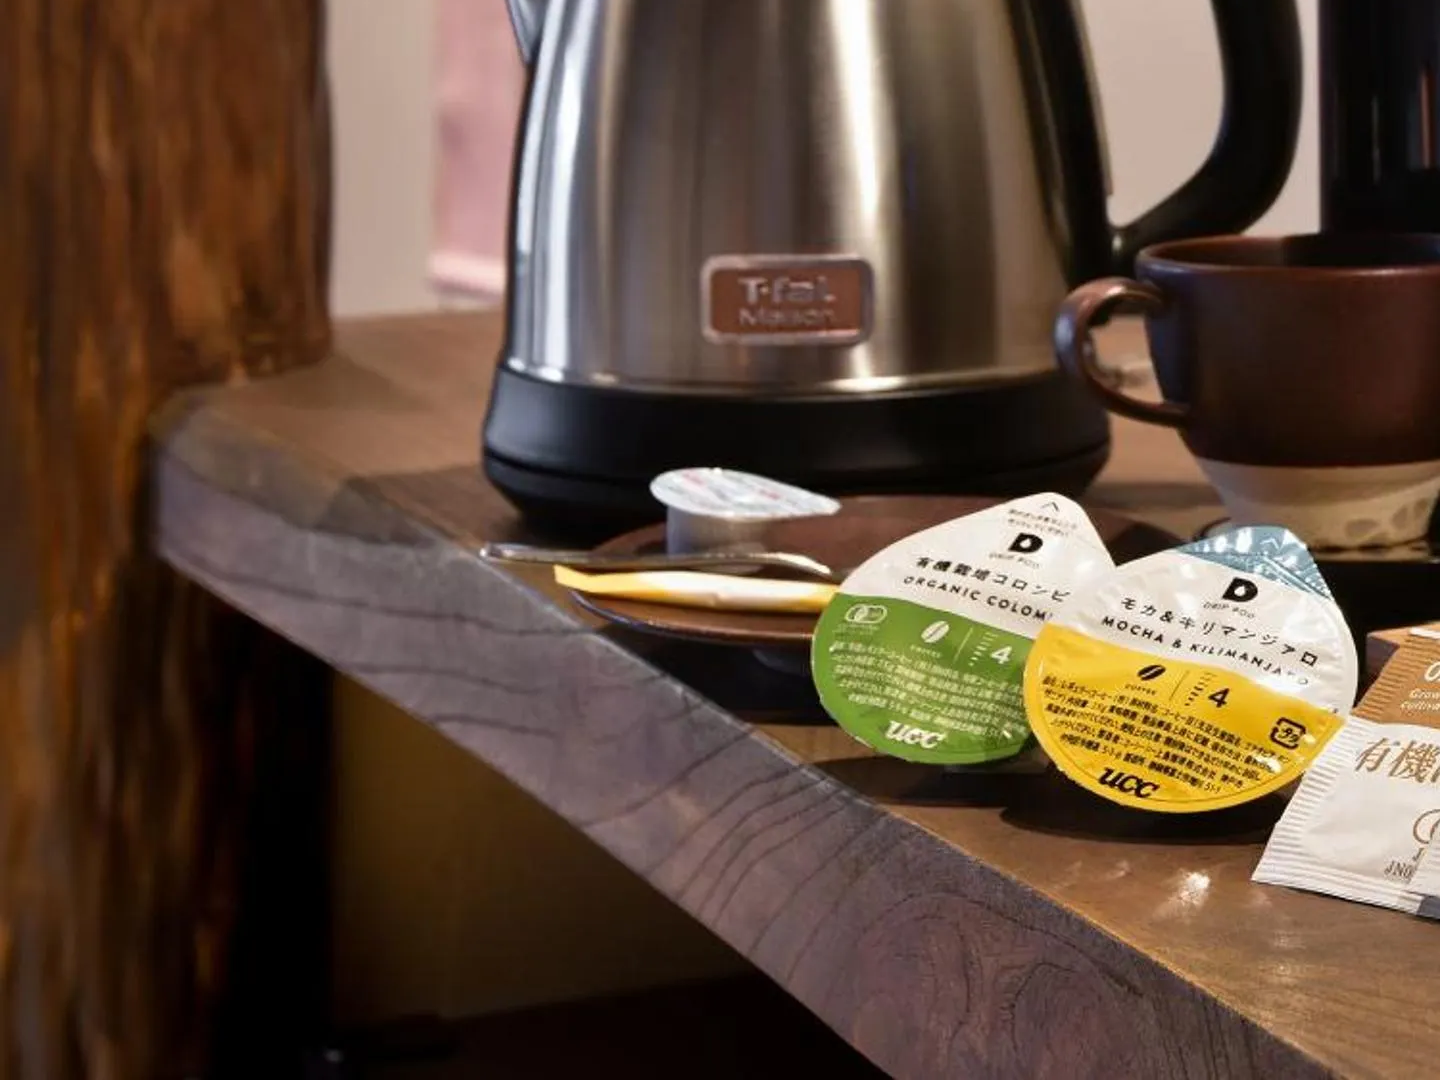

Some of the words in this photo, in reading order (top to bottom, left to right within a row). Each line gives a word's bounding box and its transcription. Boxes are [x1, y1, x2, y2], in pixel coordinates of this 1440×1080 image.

[903, 576, 982, 601] ORGANIC
[986, 595, 1053, 621] COLOM
[1101, 616, 1164, 644] MOCHA
[1172, 639, 1182, 649] &
[991, 645, 1013, 665] 4
[1208, 687, 1230, 708] 4
